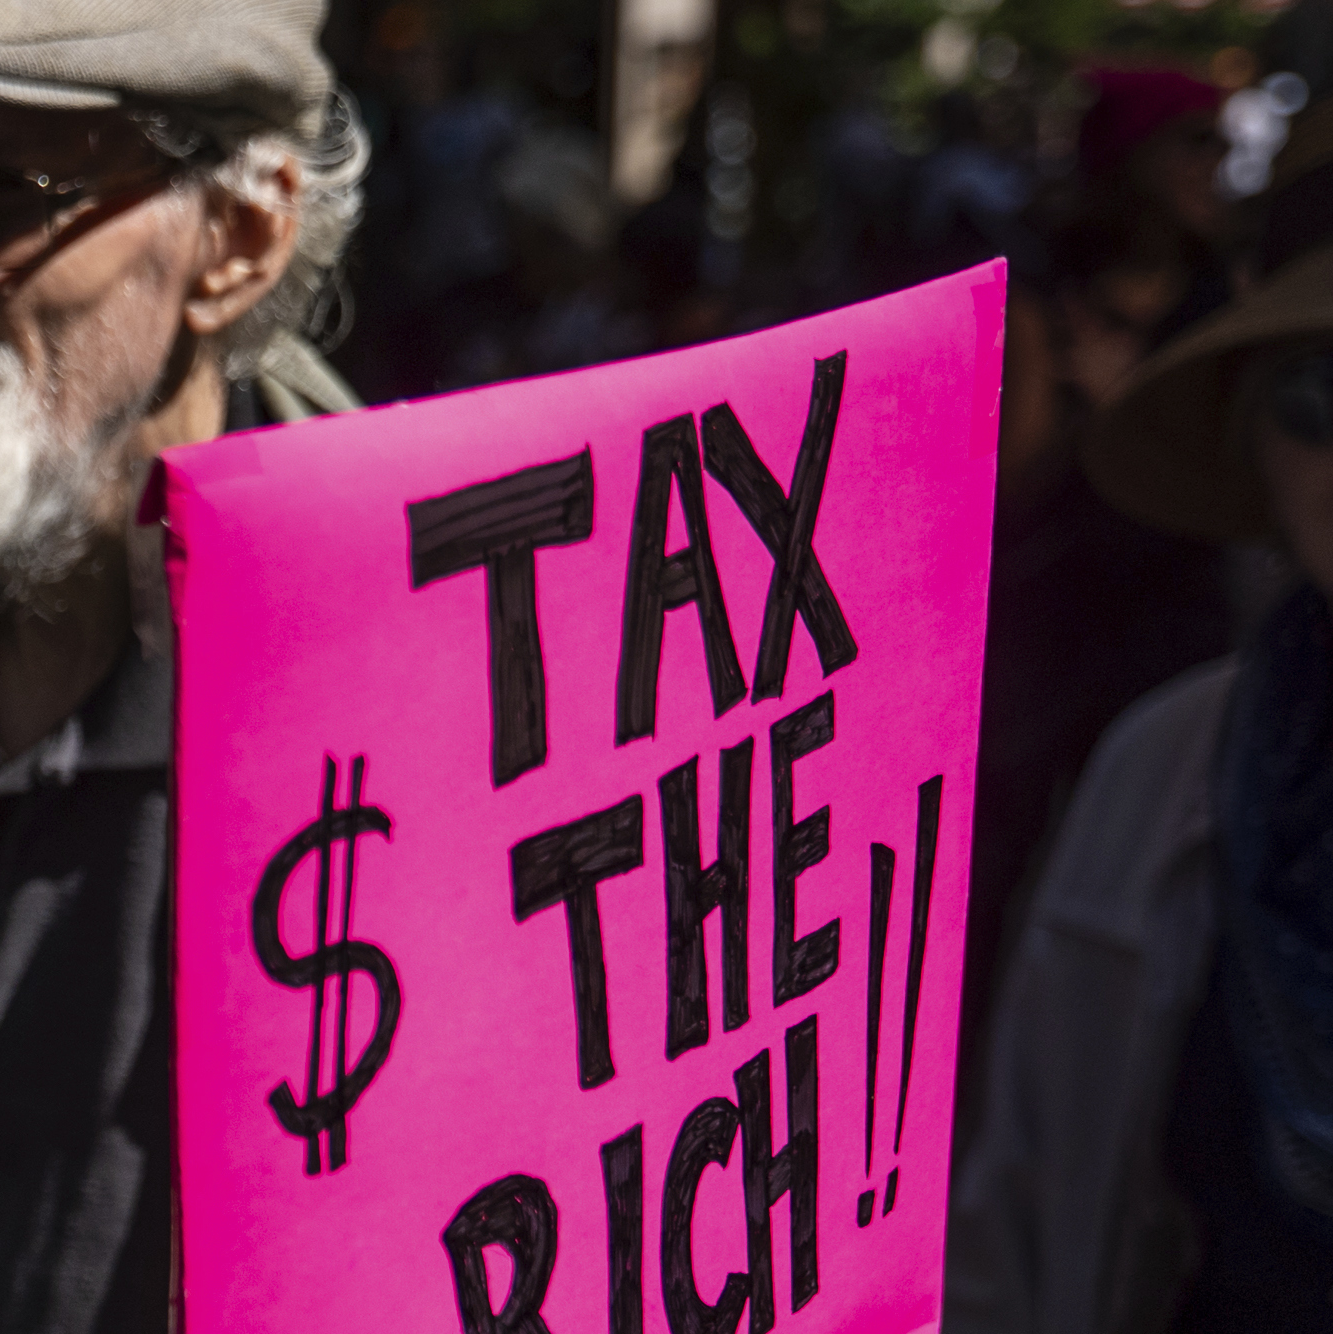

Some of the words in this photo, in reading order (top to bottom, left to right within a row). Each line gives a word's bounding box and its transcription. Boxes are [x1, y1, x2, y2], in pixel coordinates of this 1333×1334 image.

[407, 350, 859, 789] TAX
[251, 755, 402, 1176] $
[510, 690, 841, 1090] THE
